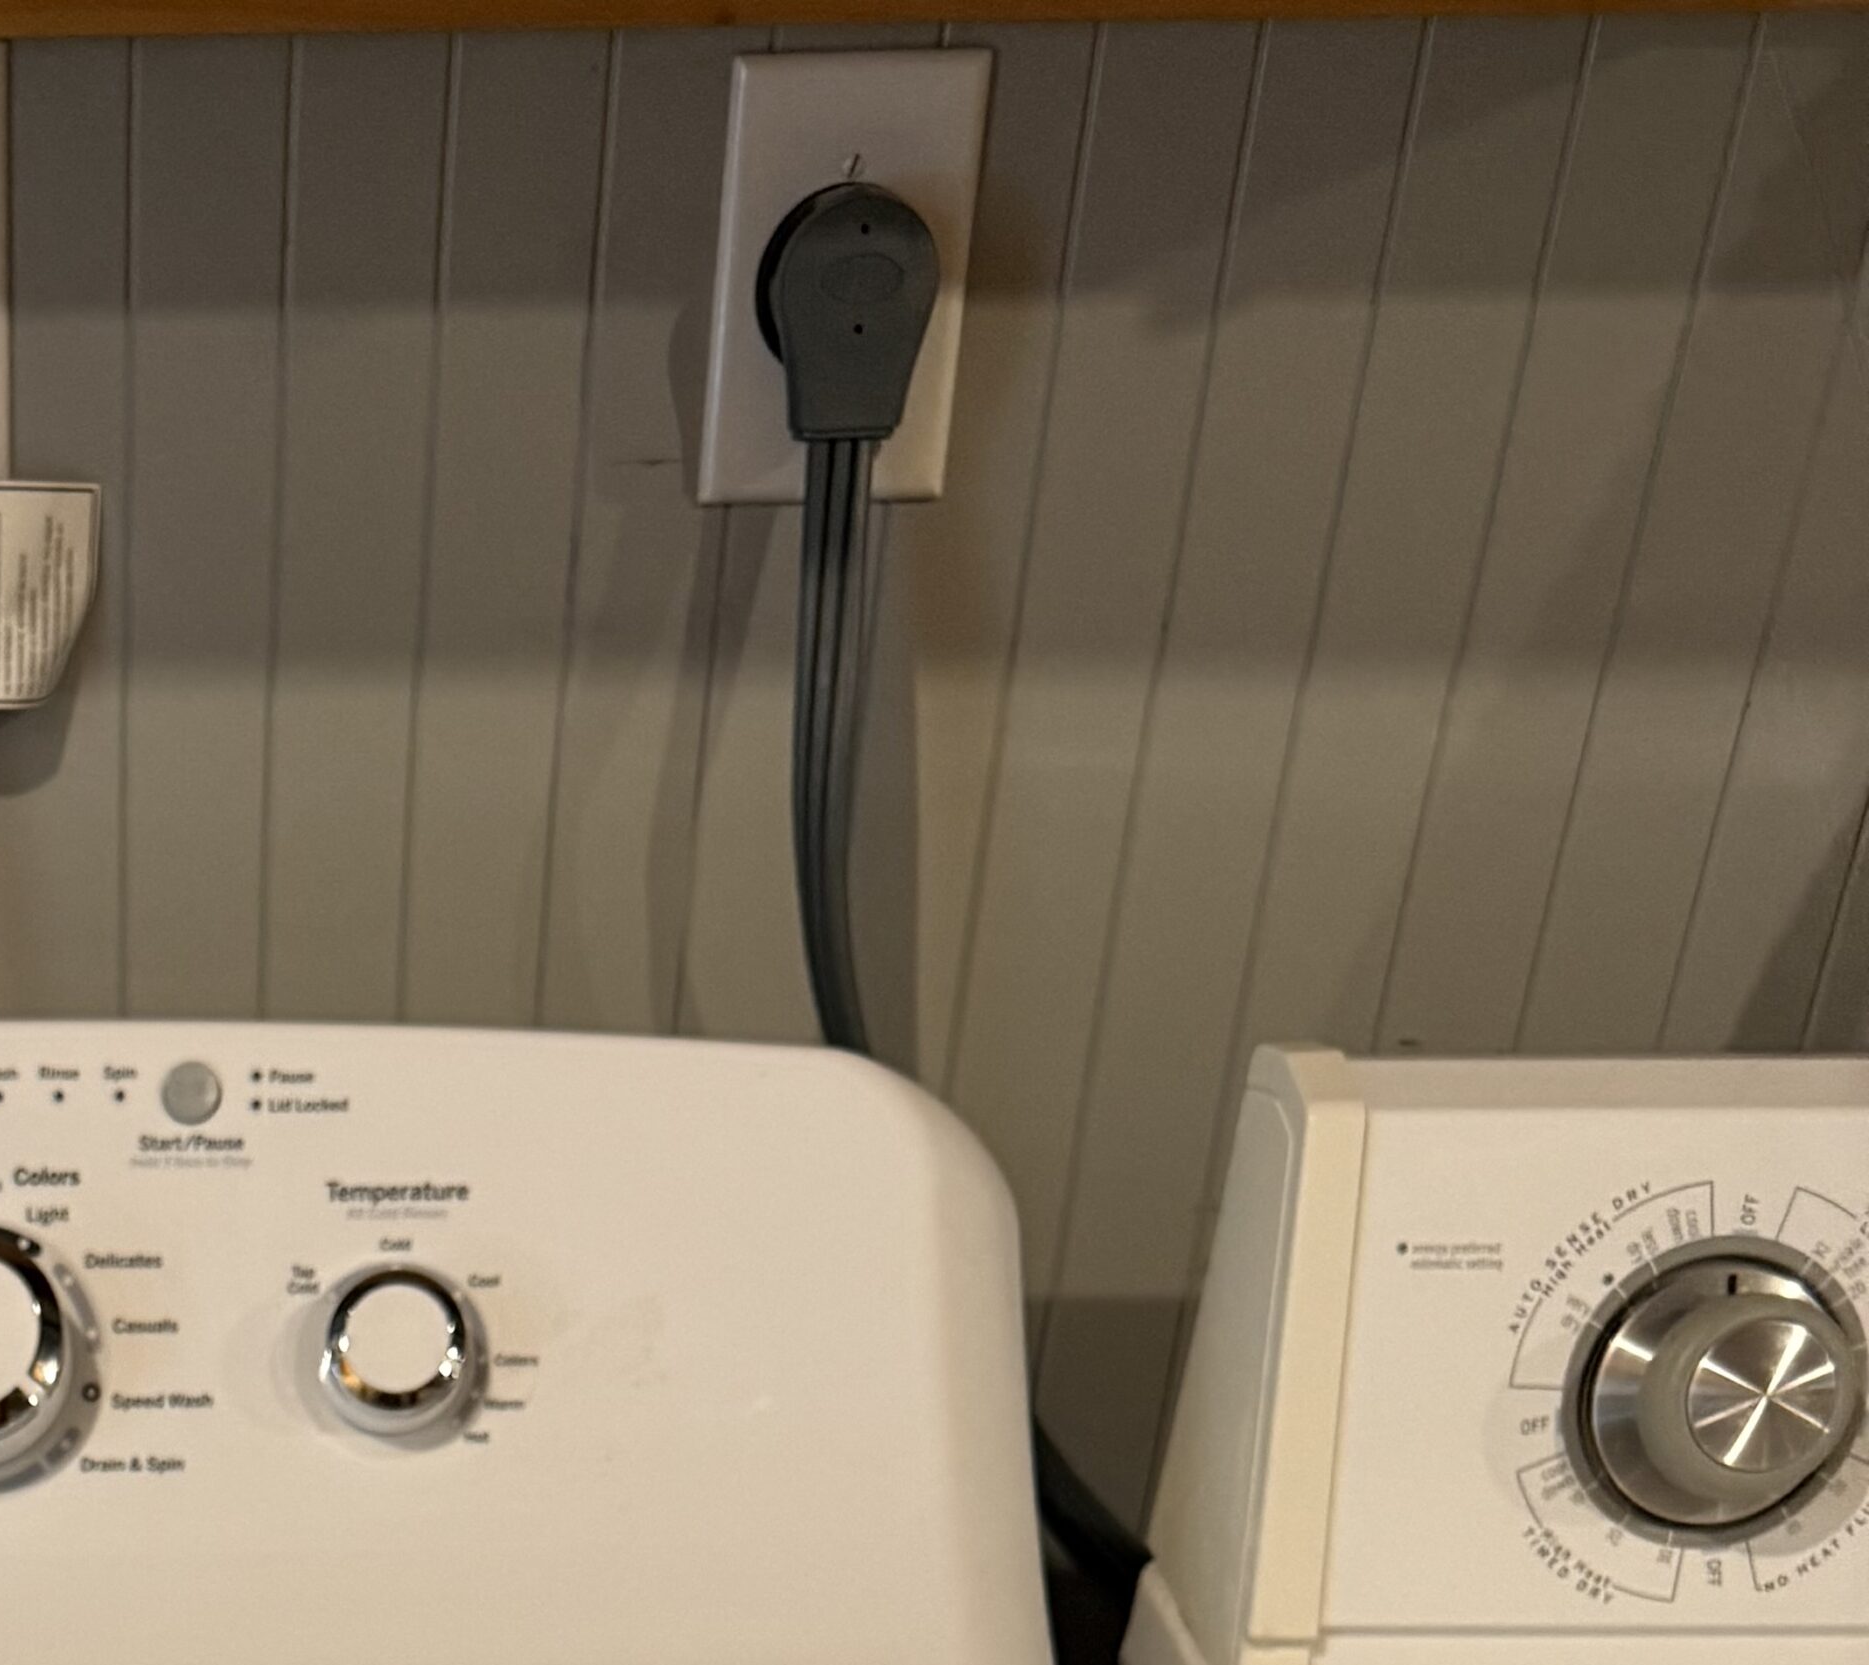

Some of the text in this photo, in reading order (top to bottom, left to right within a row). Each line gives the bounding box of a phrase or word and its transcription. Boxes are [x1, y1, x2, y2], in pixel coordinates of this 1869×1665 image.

[103, 1065, 138, 1082] Spin
[269, 1069, 314, 1083] Pause
[268, 1098, 349, 1113] Lid Locked
[139, 1135, 244, 1152] Start/Pause
[13, 1167, 80, 1186] Colors
[327, 1181, 469, 1206] Temperature
[26, 1207, 69, 1225] Light
[1739, 1194, 1760, 1227] OFF
[379, 1239, 413, 1252] Cold
[84, 1253, 163, 1269] Delicates
[1509, 1279, 1542, 1334] AUTO
[1545, 1211, 1606, 1270] SENSE
[1611, 1181, 1652, 1212] DRY
[112, 1318, 179, 1334] Casuals
[111, 1393, 214, 1412] Speed Wash
[1520, 1416, 1549, 1435] OFF
[81, 1456, 185, 1473] Drain & Spin
[1764, 1574, 1789, 1592] NO
[1796, 1538, 1840, 1577] HEAT
